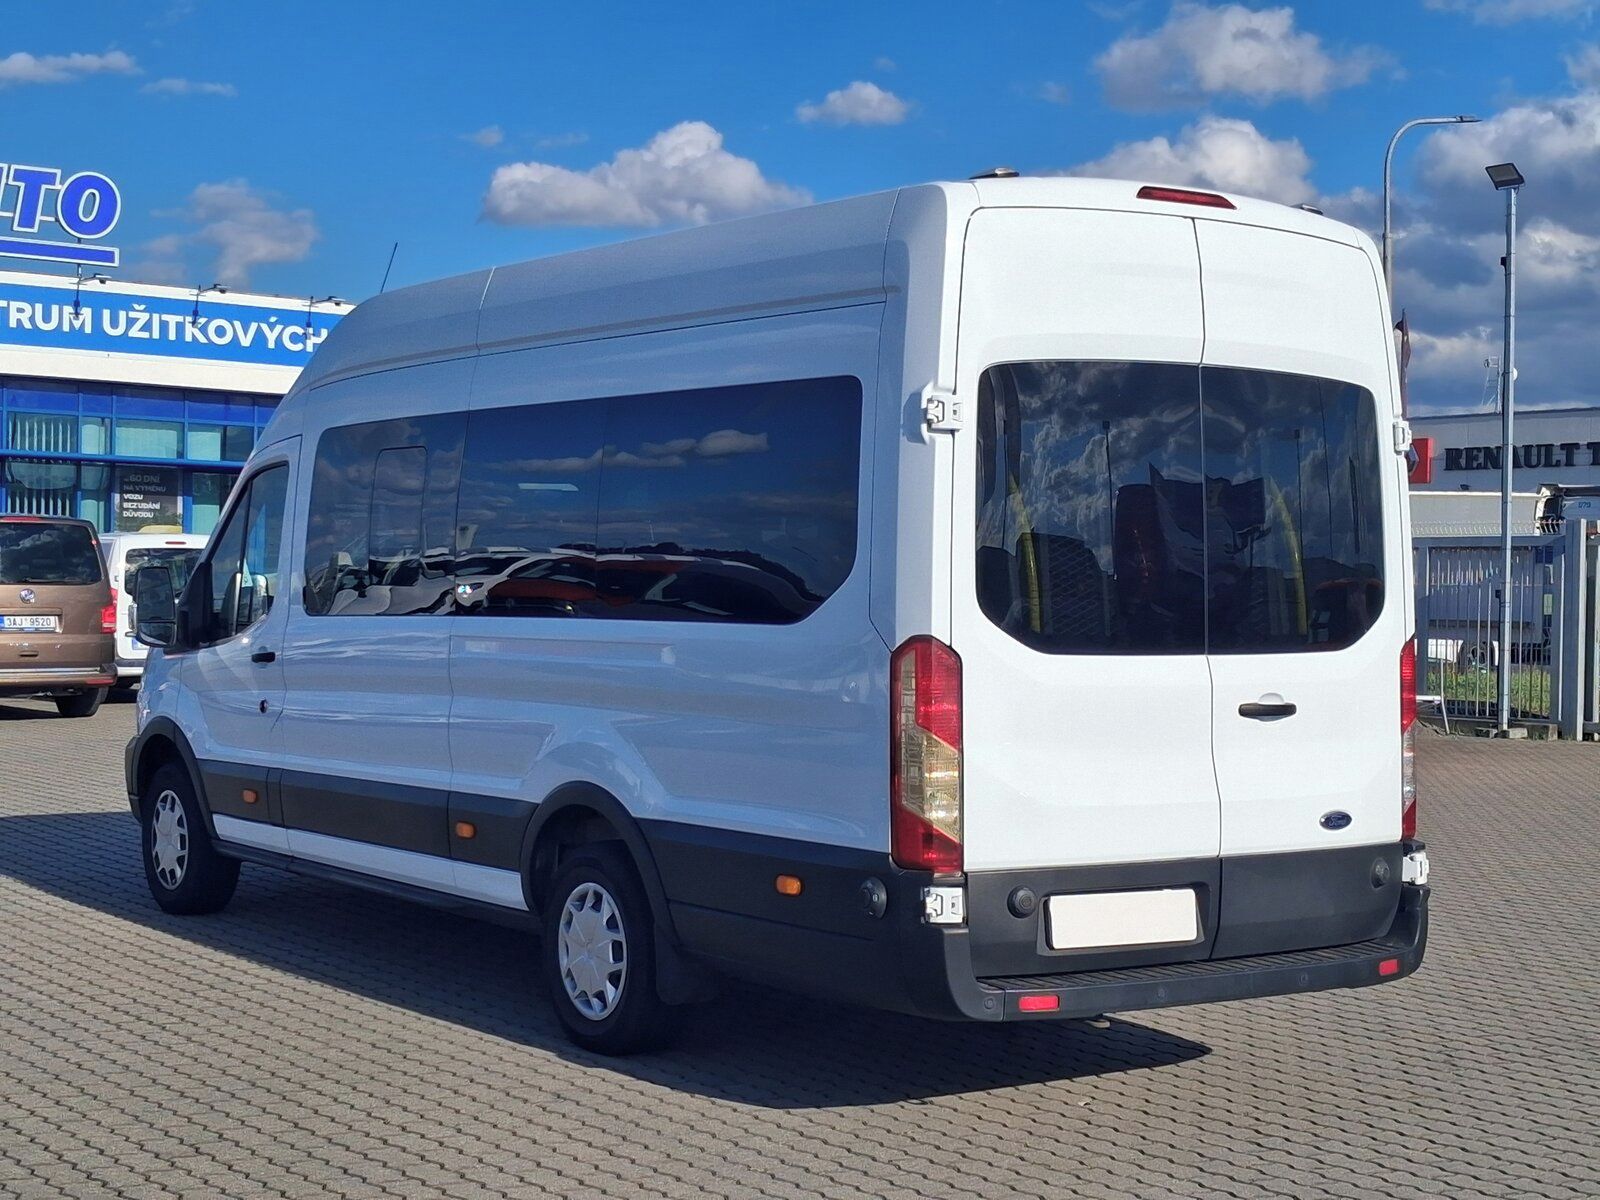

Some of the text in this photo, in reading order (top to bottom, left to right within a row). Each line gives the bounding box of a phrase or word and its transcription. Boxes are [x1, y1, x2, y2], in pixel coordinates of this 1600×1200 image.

[0, 163, 121, 239] TO
[102, 303, 328, 353] UŽITKOVÝCH
[7, 617, 51, 627] 3AJ 9520
